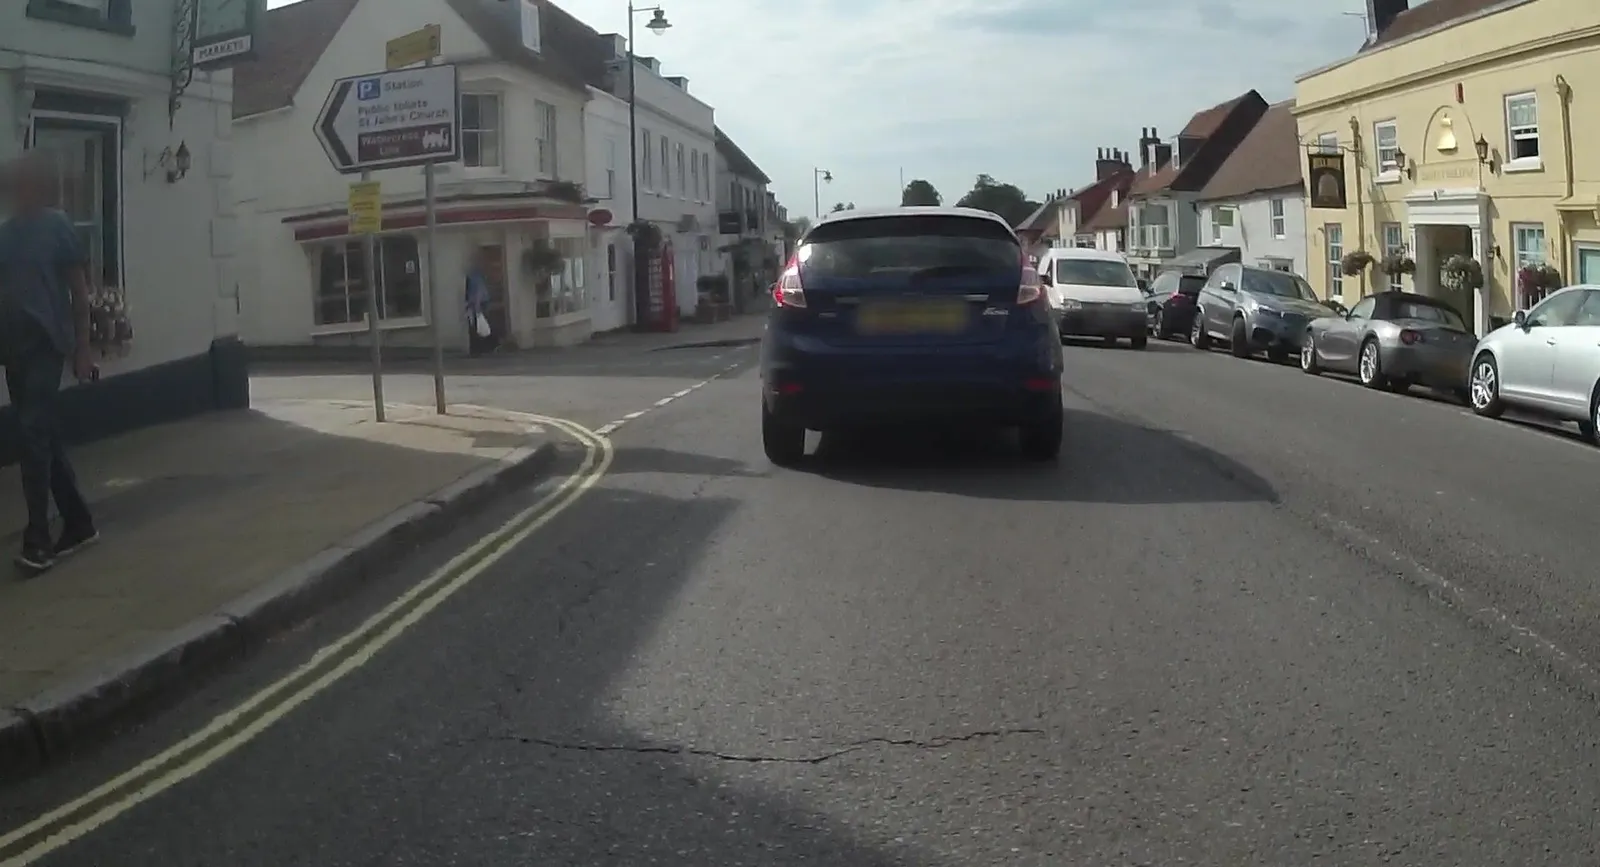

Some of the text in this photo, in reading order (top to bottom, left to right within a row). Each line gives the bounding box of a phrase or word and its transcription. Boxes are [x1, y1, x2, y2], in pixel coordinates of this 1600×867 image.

[385, 80, 423, 91] Station
[358, 100, 428, 115] Public toilets
[359, 116, 370, 127] St
[409, 108, 448, 120] Church
[361, 132, 420, 146] Watercress
